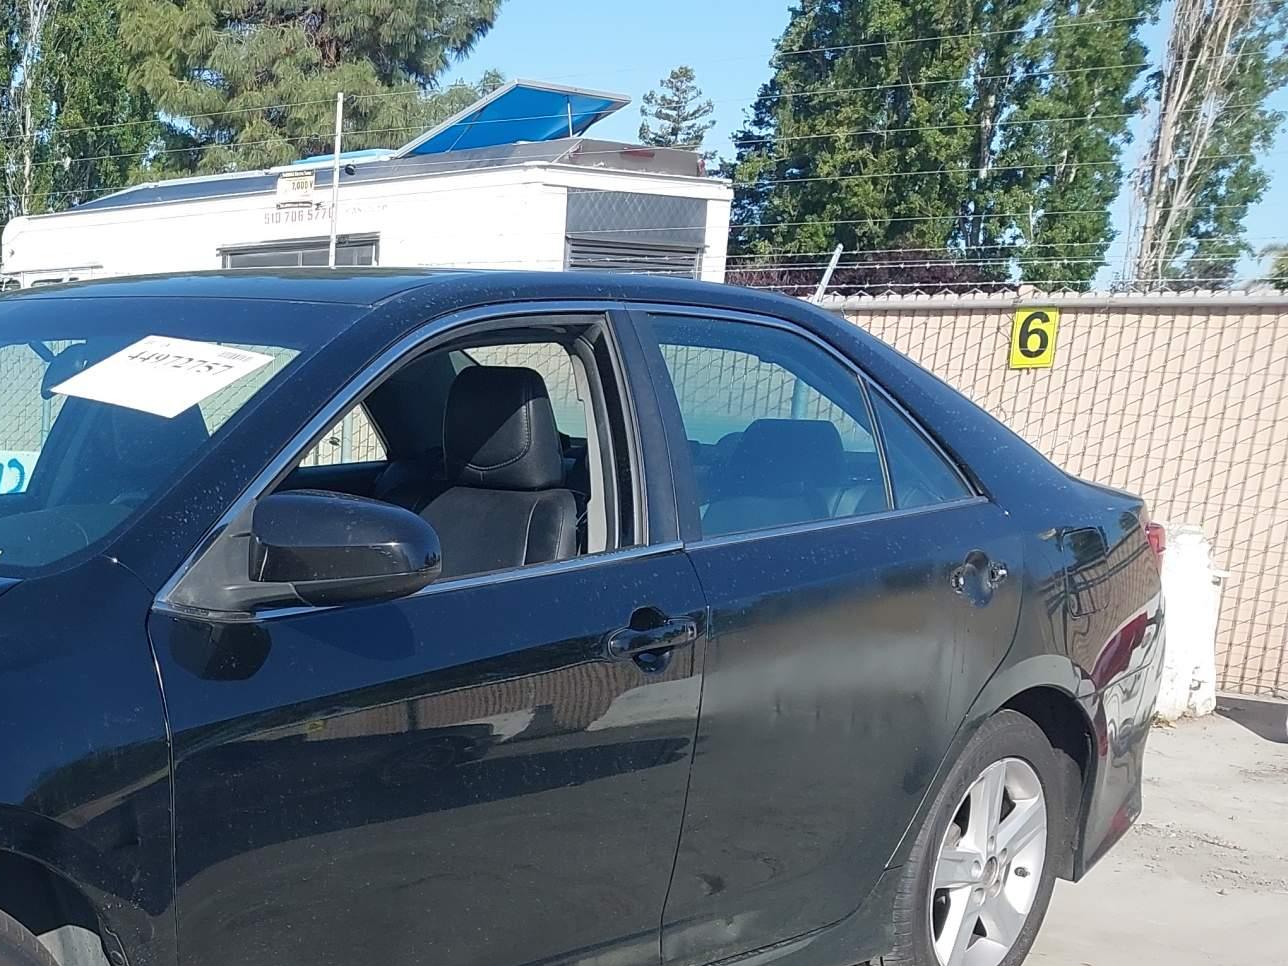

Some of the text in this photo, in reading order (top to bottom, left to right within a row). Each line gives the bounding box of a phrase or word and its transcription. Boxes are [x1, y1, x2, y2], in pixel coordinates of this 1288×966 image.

[264, 212, 281, 225] 510
[285, 209, 304, 223] 706
[1018, 311, 1051, 359] 6
[127, 350, 234, 376] 44972757
